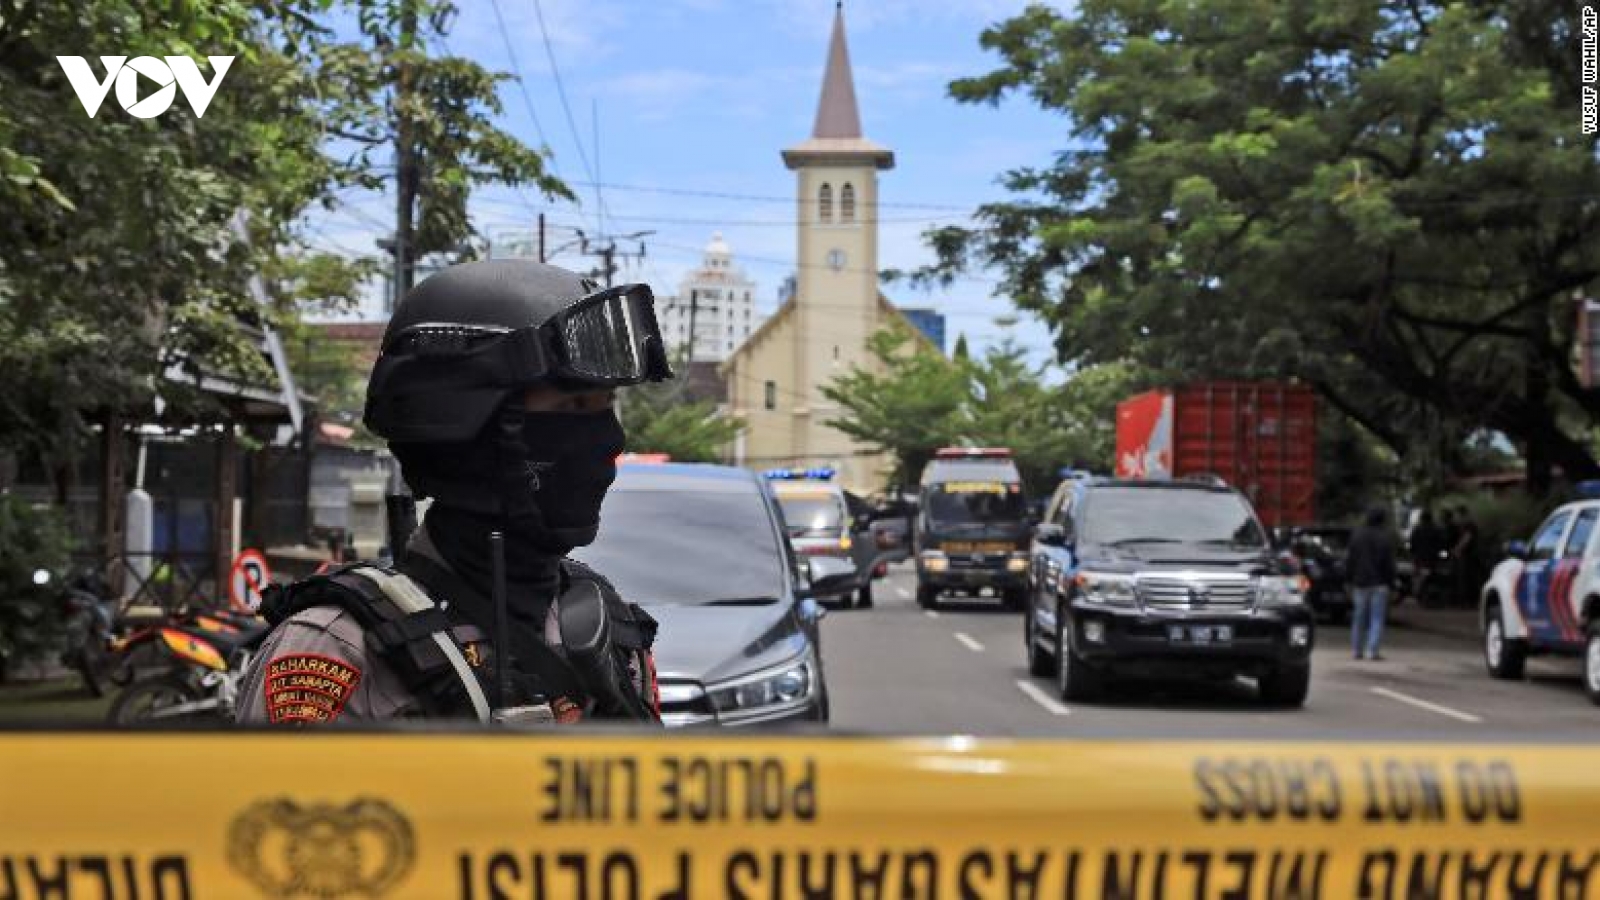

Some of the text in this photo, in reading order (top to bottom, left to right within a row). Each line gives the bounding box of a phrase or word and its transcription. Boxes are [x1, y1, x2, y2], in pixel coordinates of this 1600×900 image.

[541, 756, 816, 824] POLICE LINE
[1193, 758, 1521, 824] DO NOT CROSS
[457, 851, 691, 900] POLISI
[723, 851, 938, 900] GARIS
[957, 851, 1328, 900] MELINTAS
